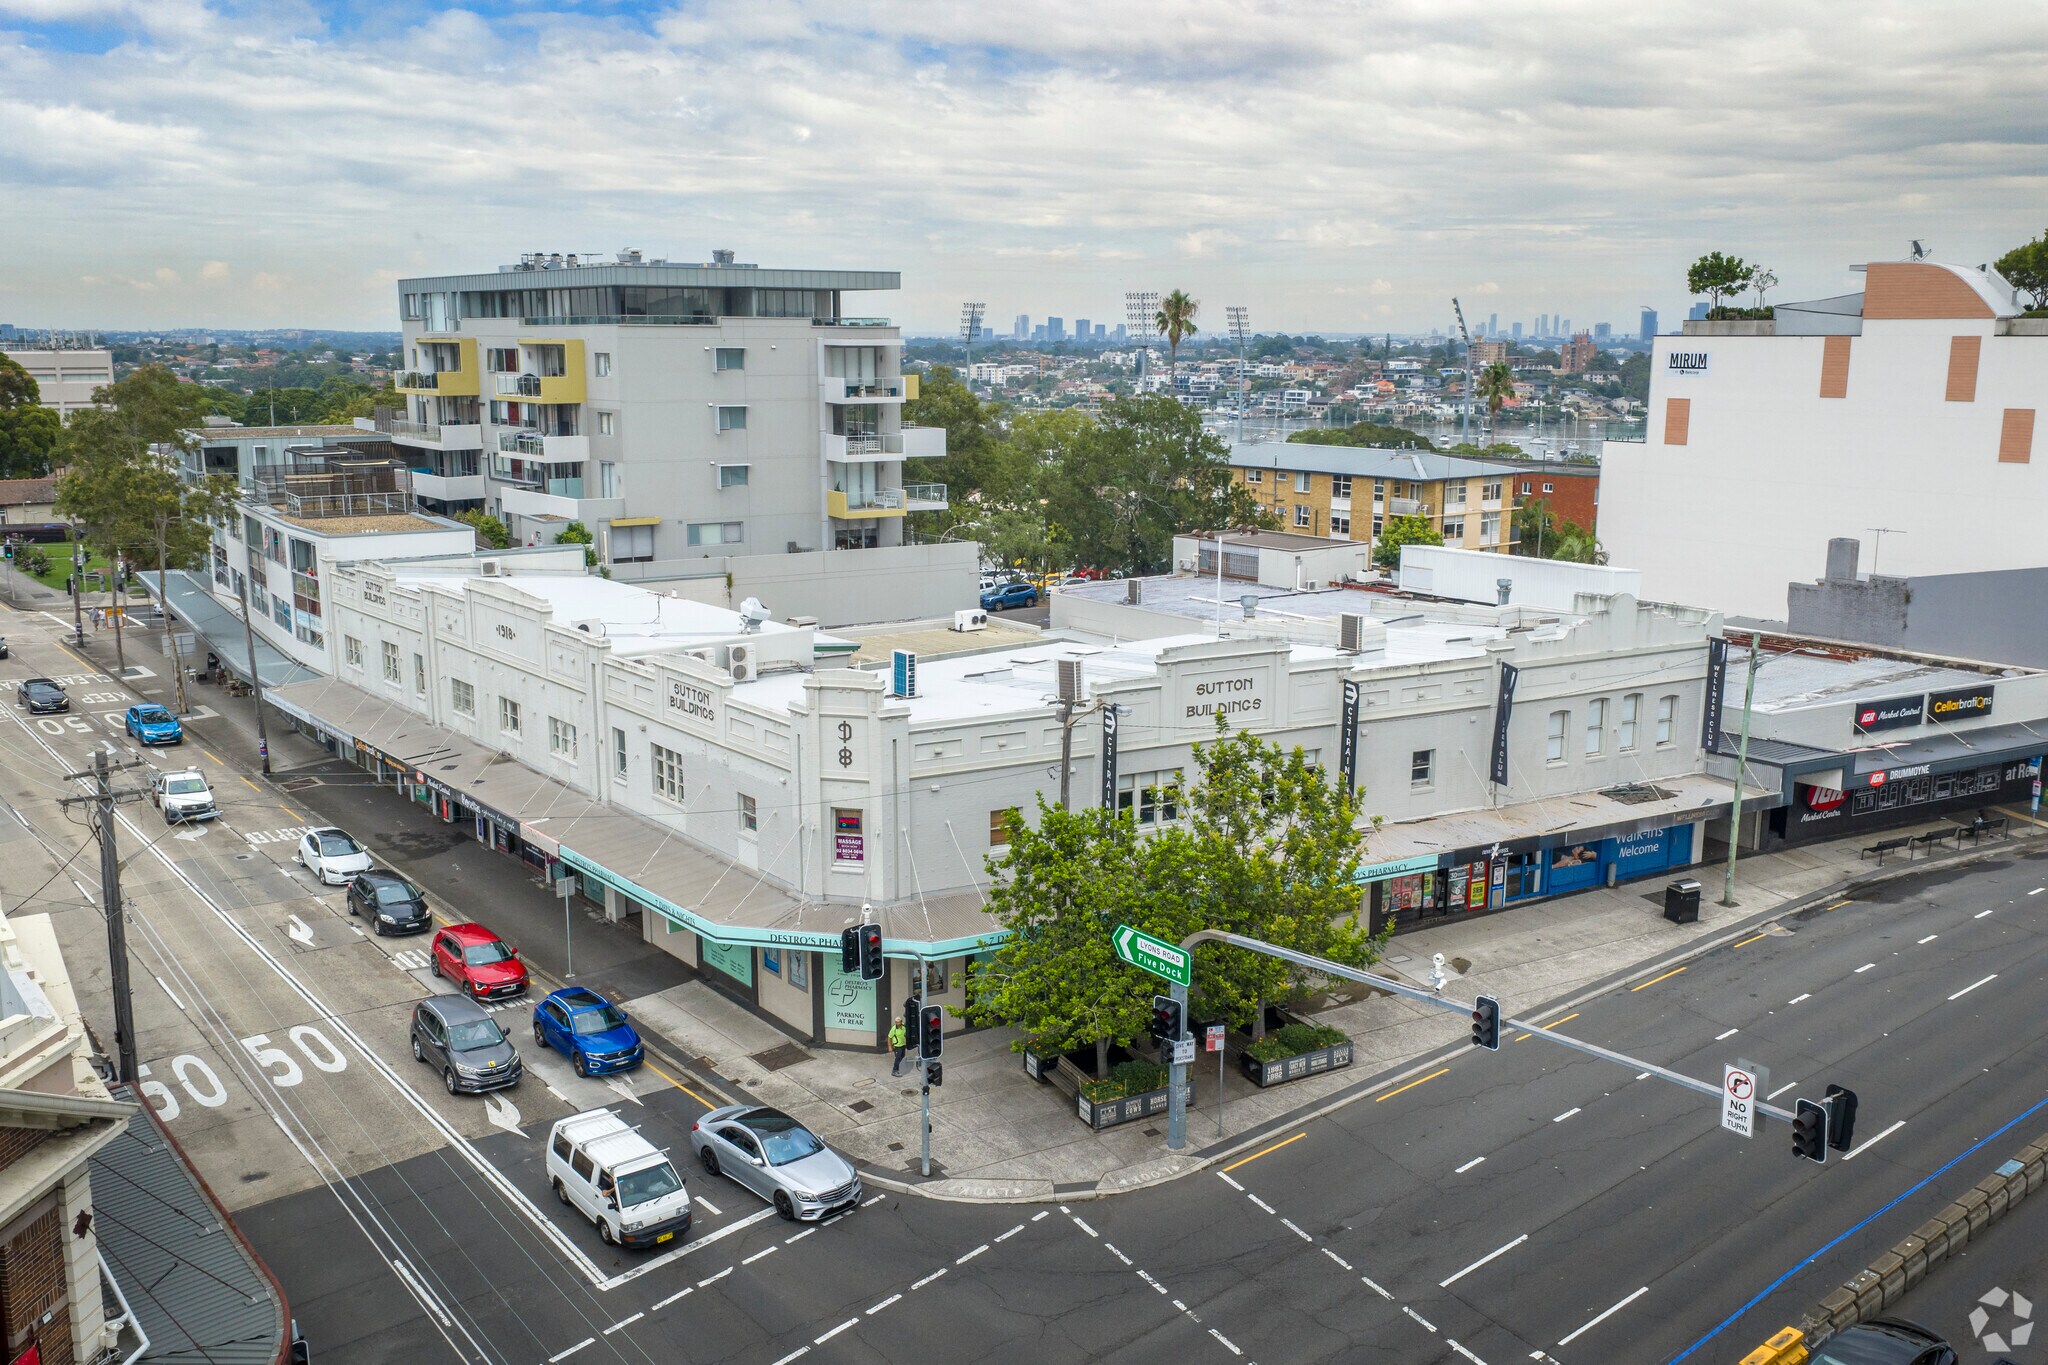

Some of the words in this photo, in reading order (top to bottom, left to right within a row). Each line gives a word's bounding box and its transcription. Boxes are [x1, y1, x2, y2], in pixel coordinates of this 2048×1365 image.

[1670, 353, 1707, 369] MIRUM
[674, 683, 710, 706] SUTTON
[1196, 678, 1253, 696] SUTTON
[1711, 665, 1720, 717] WELLNESS
[82, 692, 132, 704] KEEP
[1934, 696, 1993, 713] Cellarbrations
[670, 695, 715, 721] BUILDINGS
[1186, 698, 1262, 718] BUILDINGS
[1345, 707, 1353, 724] C3
[1861, 713, 1875, 723] IGA
[1878, 709, 1900, 721] Market
[1900, 706, 1921, 717] Central
[37, 717, 94, 735] 50
[1870, 773, 1884, 784] IGA
[1890, 765, 1930, 780] DRUMMOYNE
[2005, 767, 2017, 781] at
[1801, 809, 1822, 823] Market
[1368, 863, 1409, 877] PHARMACY
[1474, 861, 1485, 870] 30
[770, 934, 816, 946] DESTRO'S
[1140, 941, 1161, 955] LYONS
[1162, 950, 1181, 963] ROAD
[1138, 953, 1157, 968] Five
[1159, 962, 1182, 979] Dock
[836, 1011, 865, 1019] PARKING
[240, 1025, 347, 1087] 50
[1267, 1071, 1283, 1080] 1882
[138, 1055, 227, 1122] 50
[1730, 1099, 1747, 1113] NO
[1727, 1110, 1747, 1123] RIGHT
[1727, 1119, 1748, 1132] TURN
